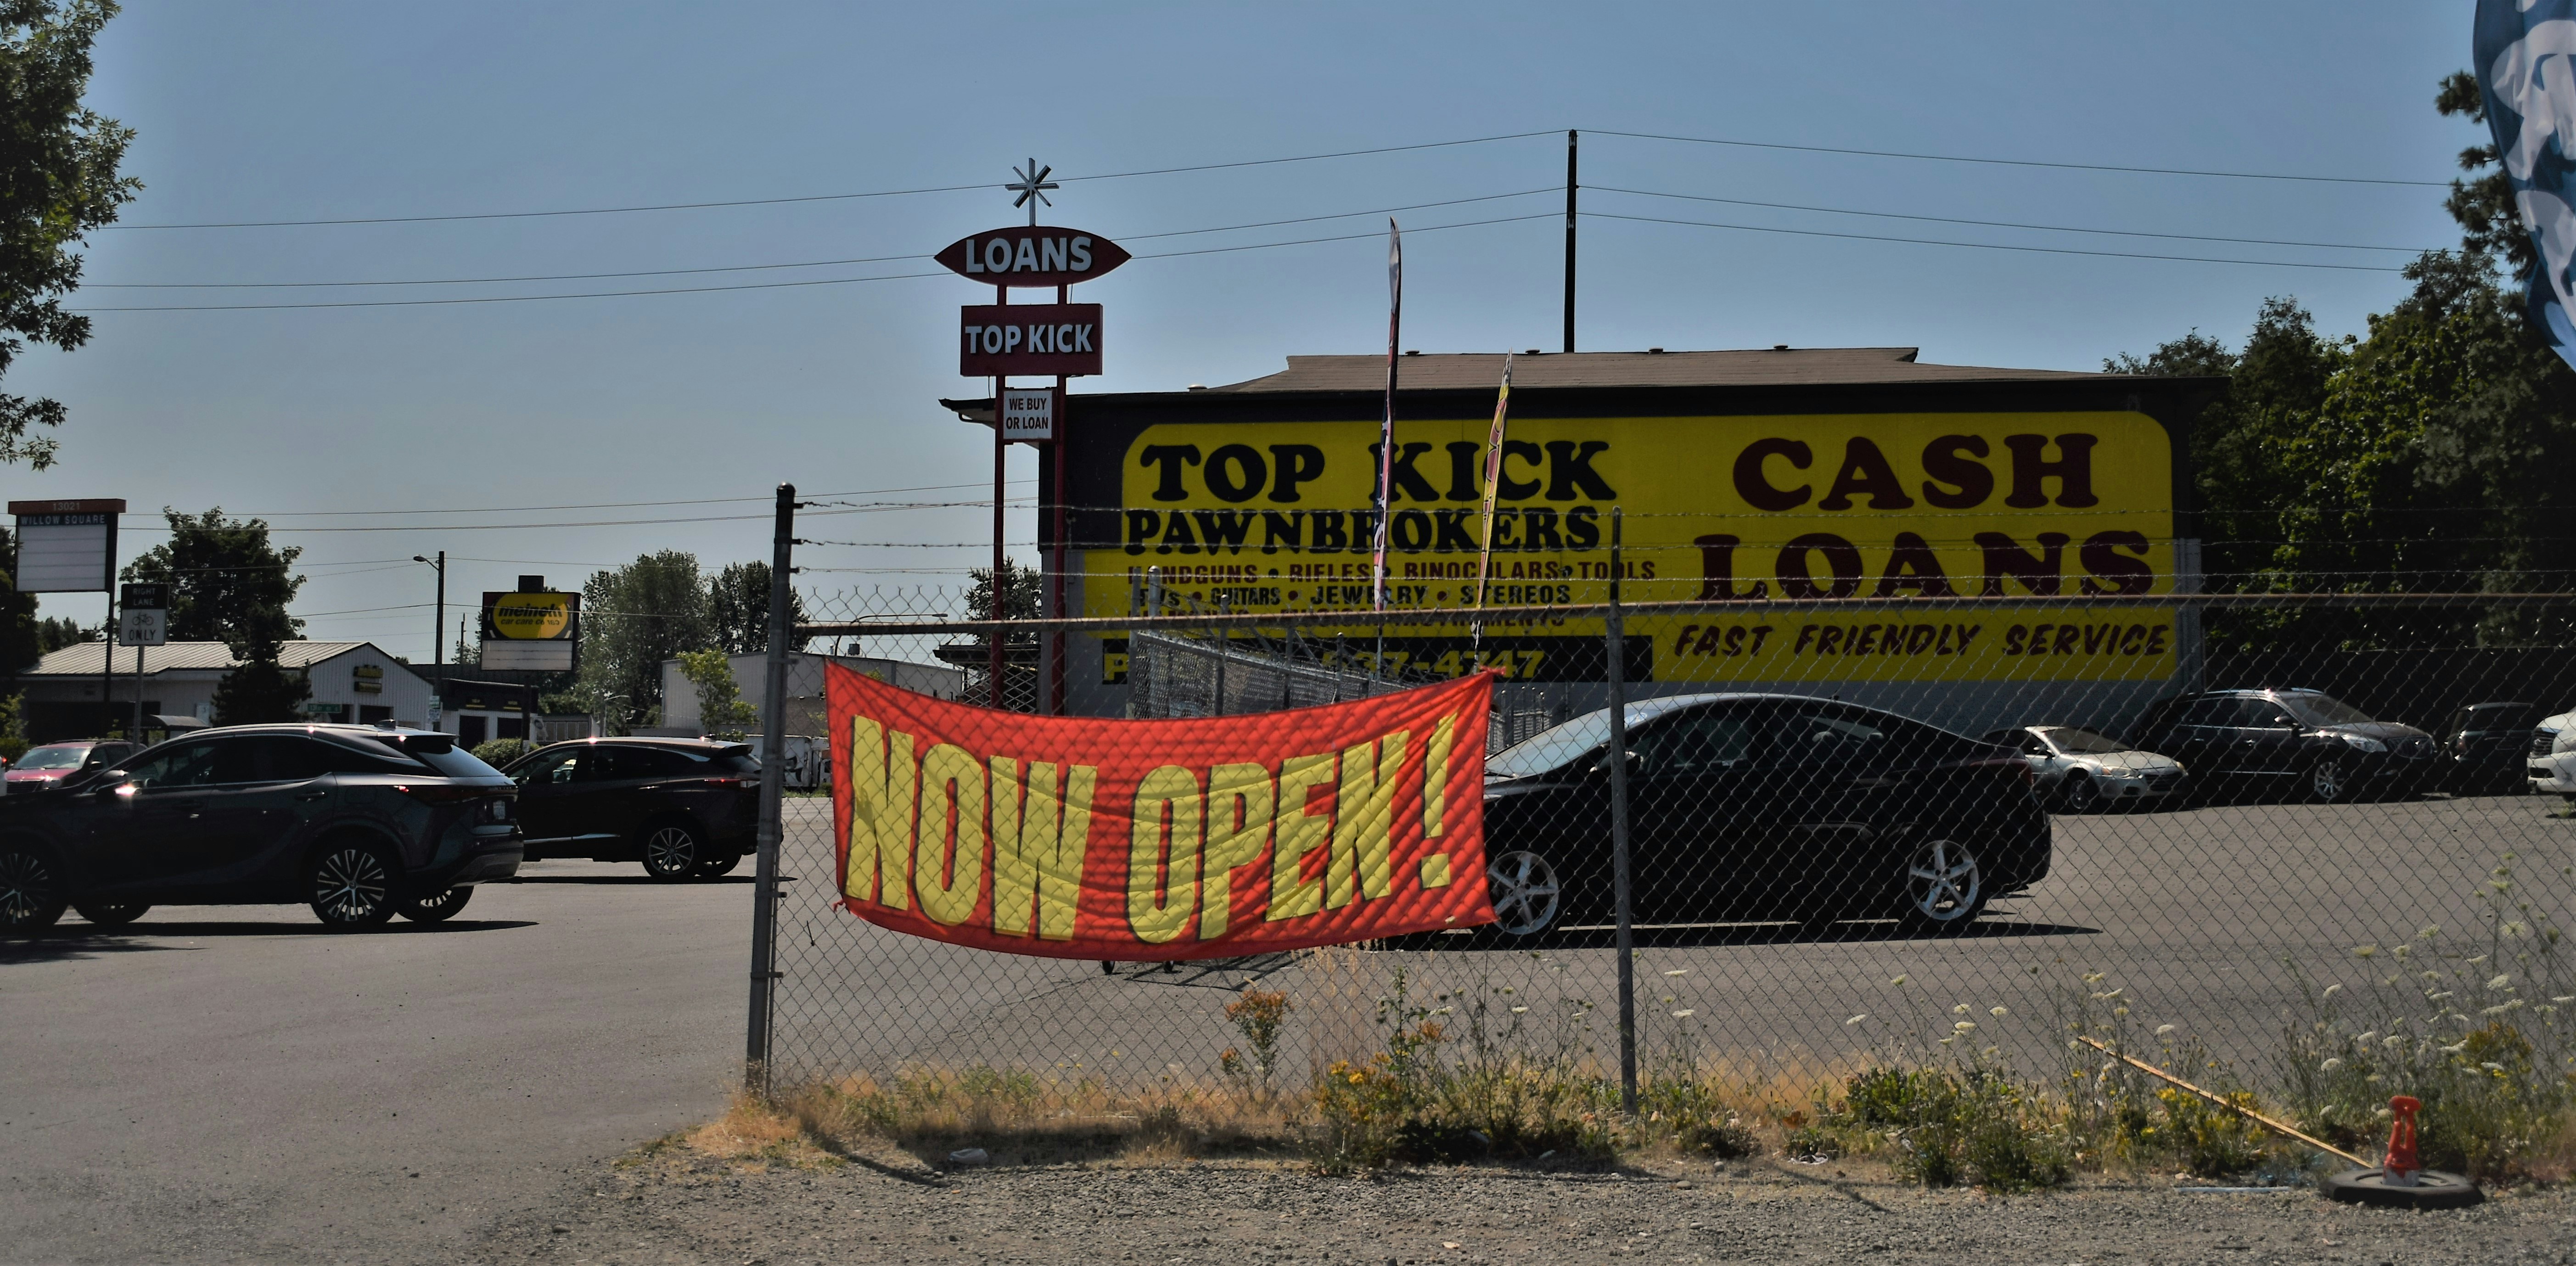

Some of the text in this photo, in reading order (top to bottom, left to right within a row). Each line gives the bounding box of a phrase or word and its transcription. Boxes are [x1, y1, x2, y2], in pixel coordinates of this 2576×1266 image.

[965, 236, 1092, 273] LOANS
[965, 324, 1093, 354] TOP KICK
[1009, 398, 1047, 411] WE BUY
[1006, 417, 1049, 429] OR LOAN
[1140, 441, 1617, 503] TOP KICK
[1733, 433, 2099, 512] CASH
[21, 515, 106, 525] WILLOW SQUARE
[53, 502, 80, 511] 13021
[1125, 505, 1600, 555] PAWNBROKERS
[1289, 563, 1370, 583] RIFLES
[1693, 530, 2154, 601] LOANS
[1211, 587, 1280, 606] GUITARS
[129, 629, 156, 641] ONLY
[1674, 623, 2170, 657] FAST FRIENDLY SERVICE
[846, 714, 1098, 940] NOW
